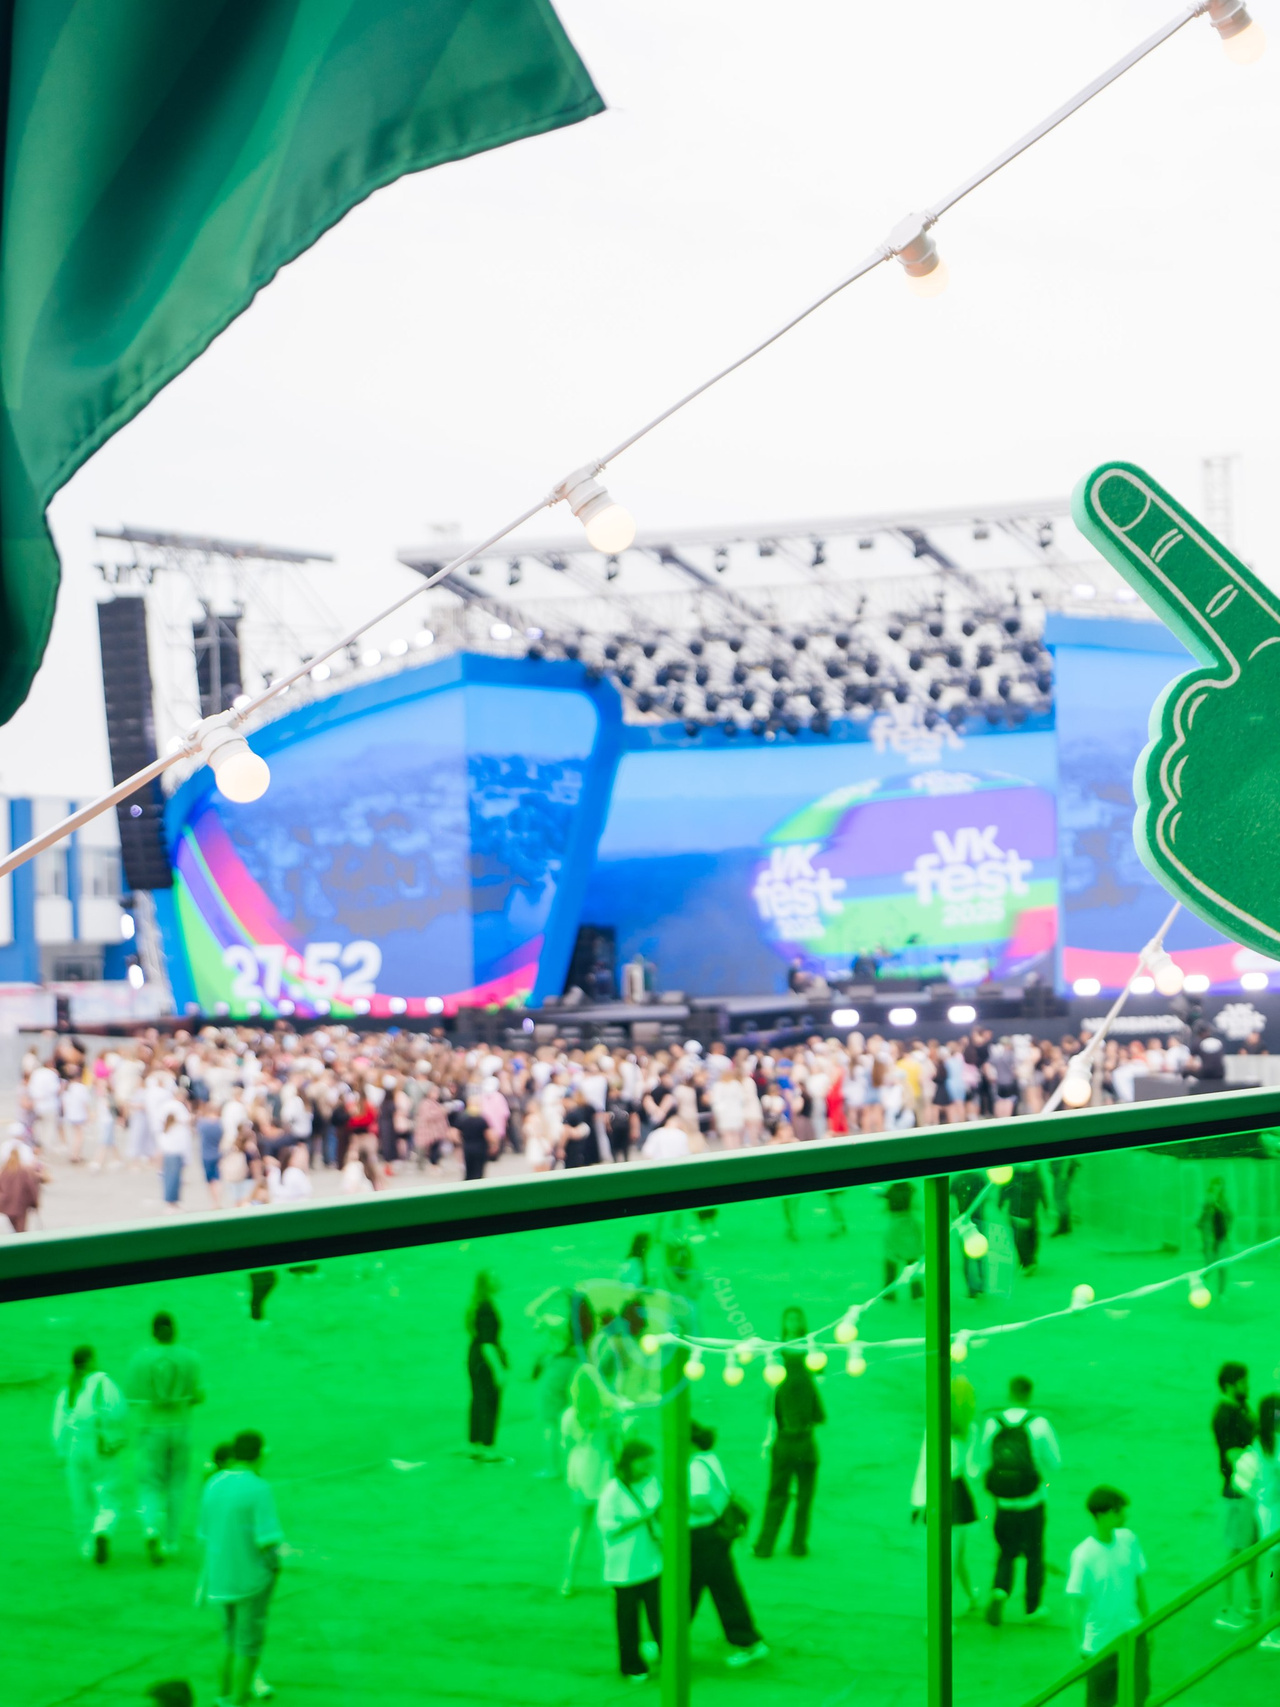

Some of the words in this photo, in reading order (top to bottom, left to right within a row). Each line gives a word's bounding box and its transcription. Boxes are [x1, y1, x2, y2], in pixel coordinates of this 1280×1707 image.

[933, 825, 1006, 864] VK
[752, 867, 847, 921] fest
[903, 849, 1034, 905] fest
[222, 940, 383, 1000] 27:52
